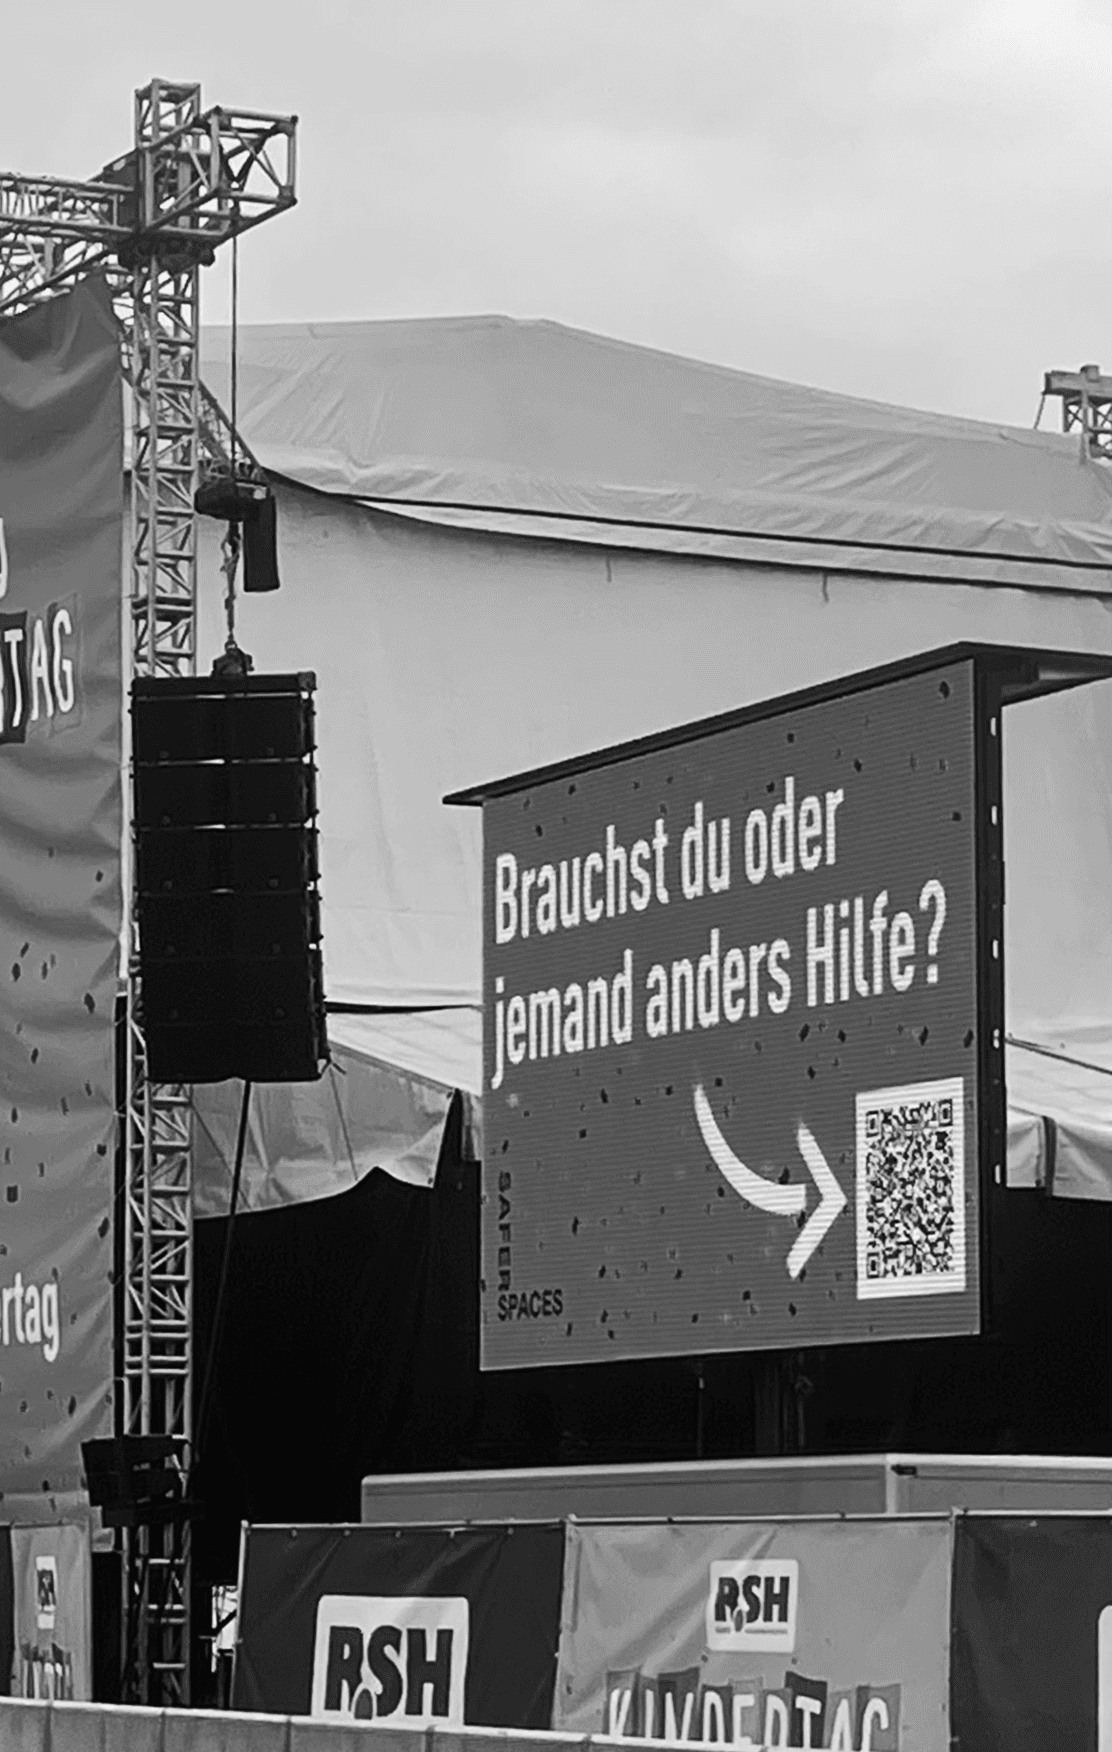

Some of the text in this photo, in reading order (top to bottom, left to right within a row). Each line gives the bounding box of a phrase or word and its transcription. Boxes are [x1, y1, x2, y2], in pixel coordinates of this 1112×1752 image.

[495, 776, 844, 943] Brauchst du oder
[492, 879, 947, 1089] jemand anders Hilfe?
[498, 1289, 563, 1321] SPACES
